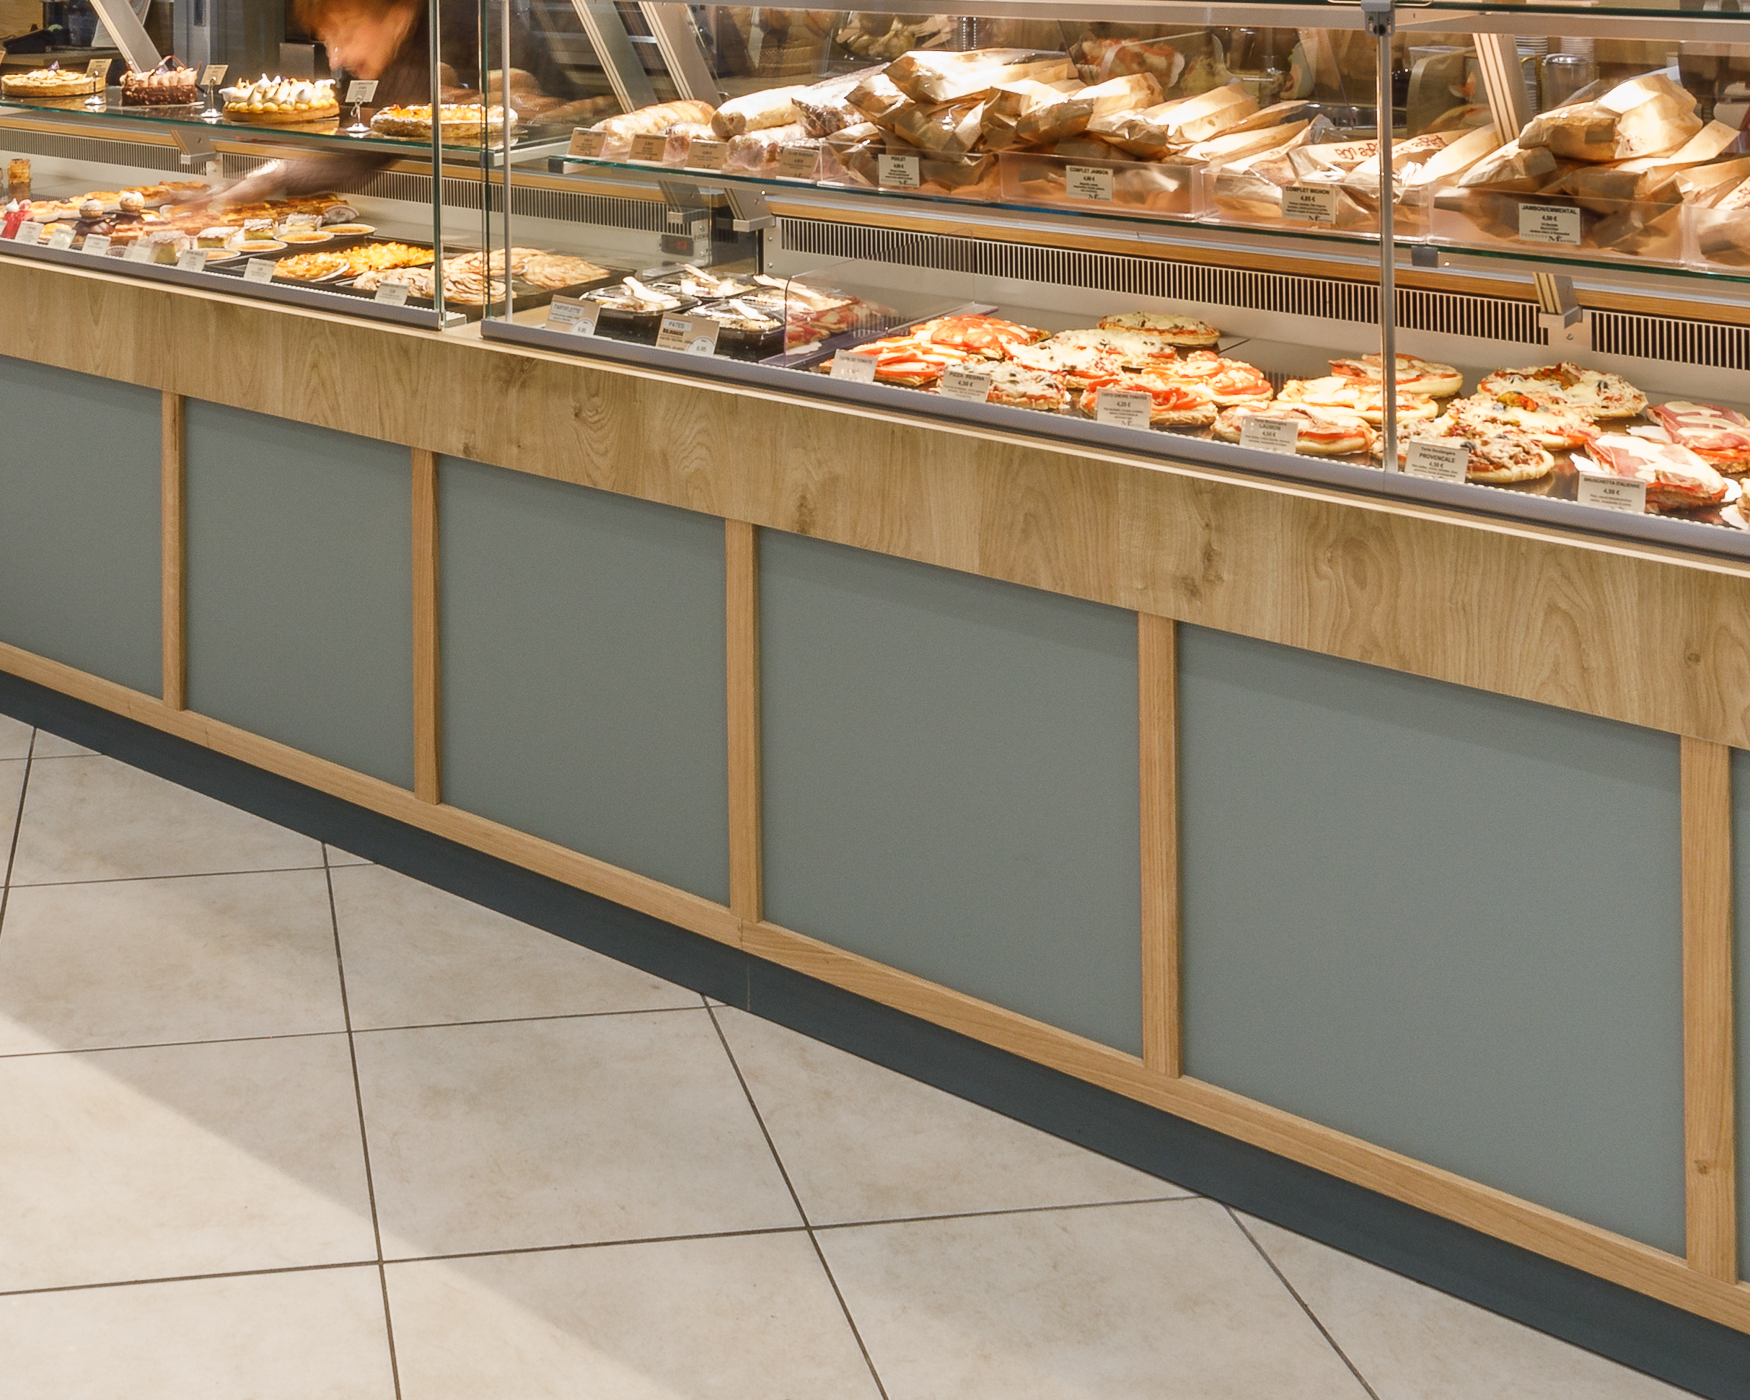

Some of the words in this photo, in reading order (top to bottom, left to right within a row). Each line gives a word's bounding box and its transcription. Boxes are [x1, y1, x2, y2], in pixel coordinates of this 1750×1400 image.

[1522, 205, 1577, 215] JAMBON/EMMENTAL
[553, 304, 581, 314] TARTIFLETTE
[949, 371, 964, 379] PIZZA
[965, 374, 985, 382] REGINA
[1419, 452, 1456, 463] PROVENCALE
